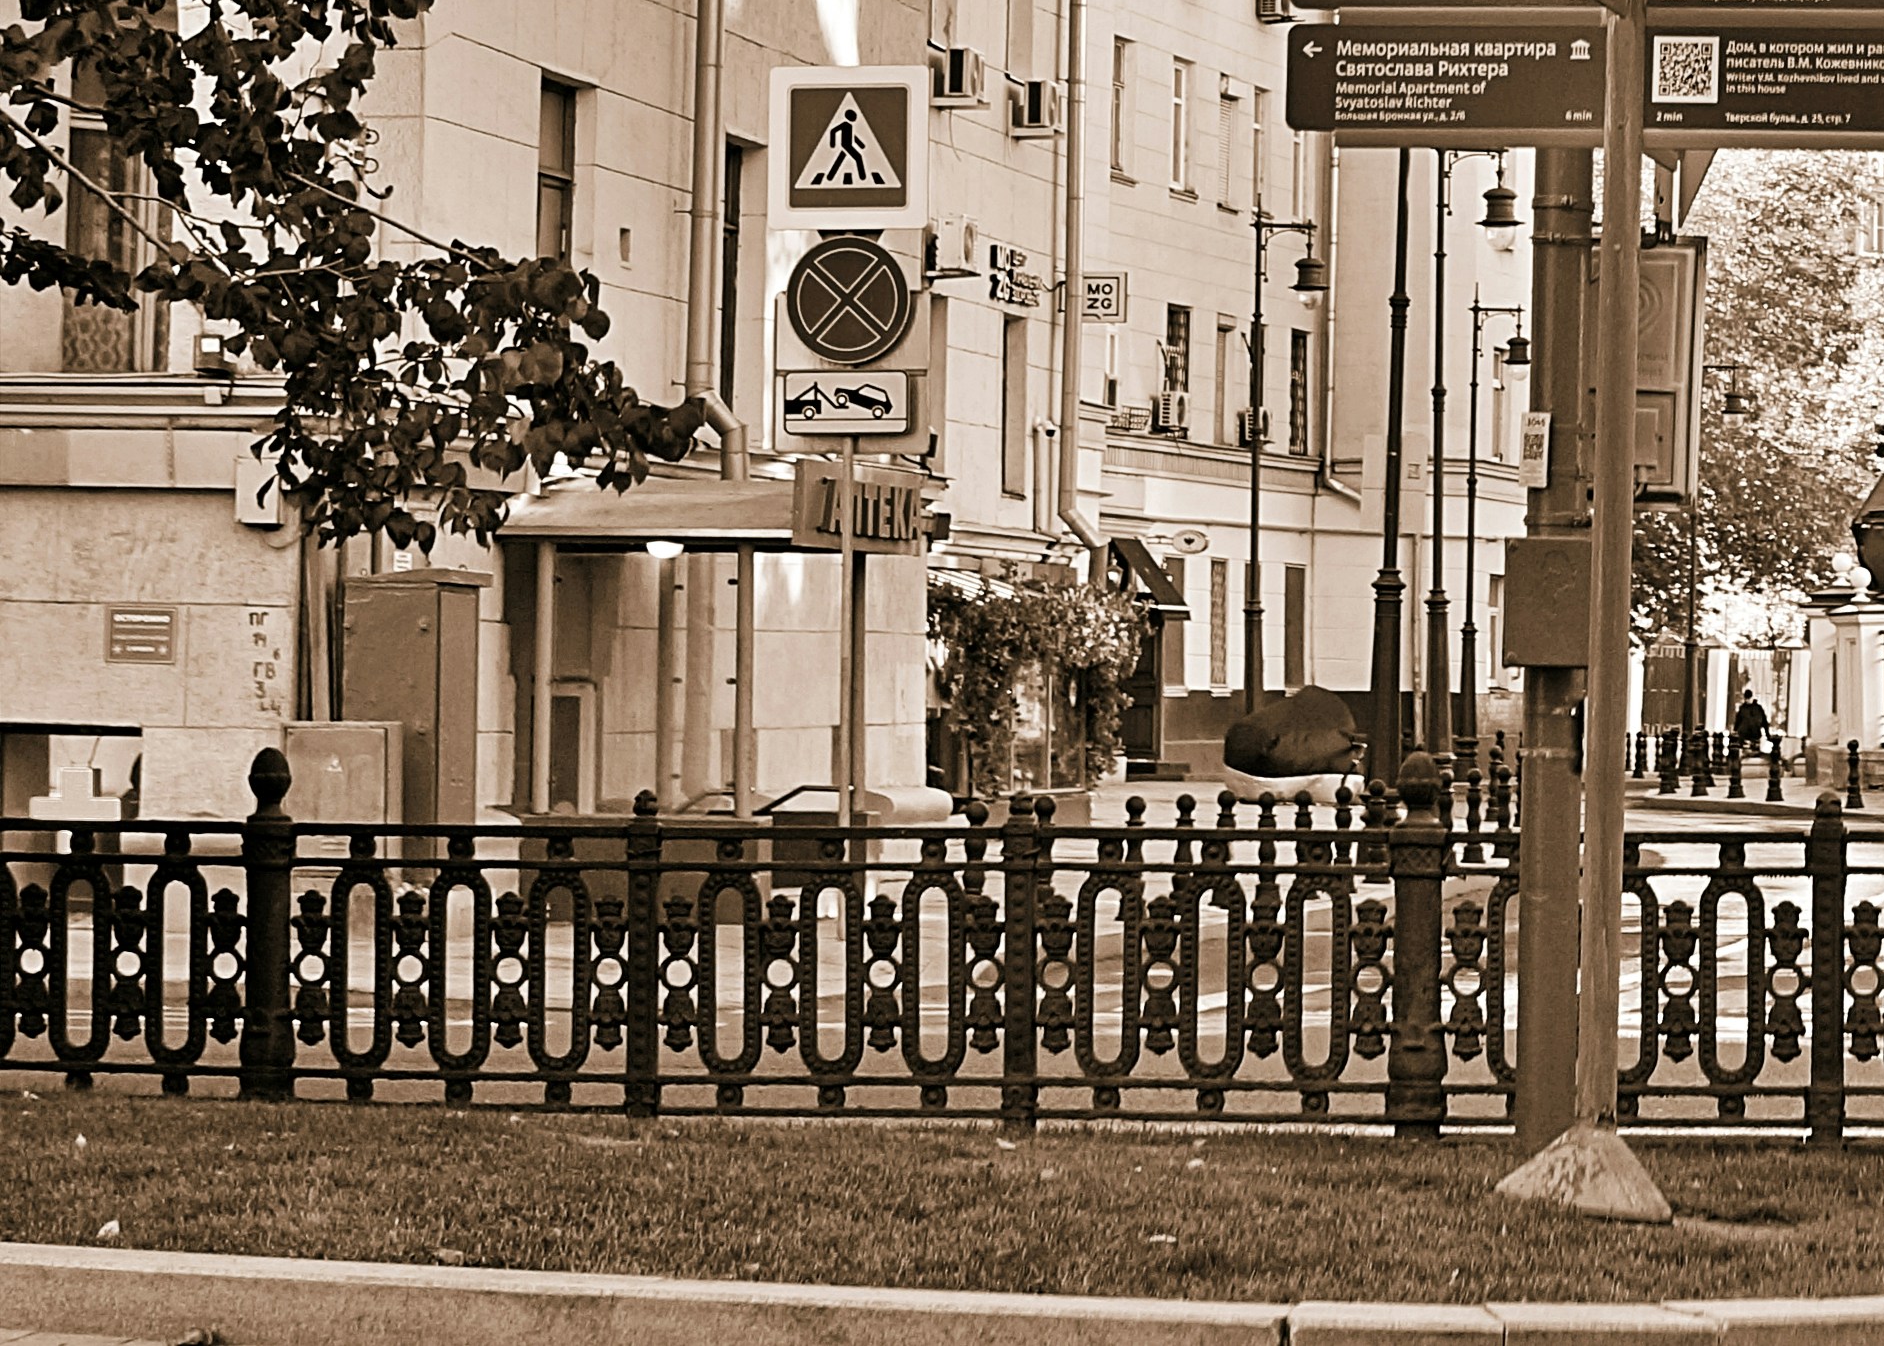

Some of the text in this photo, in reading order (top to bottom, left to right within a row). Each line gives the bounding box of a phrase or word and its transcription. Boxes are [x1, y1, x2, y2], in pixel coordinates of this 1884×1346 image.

[1337, 40, 1556, 60] Мемориальная квартира
[1726, 41, 1756, 56] Дом,
[1759, 44, 1766, 53] в
[1769, 44, 1824, 56] котором
[1827, 44, 1853, 53] жил
[1856, 44, 1864, 54] и
[1336, 60, 1508, 79] Святослава Рихтера
[1726, 58, 1784, 70] писатель
[1787, 58, 1813, 69] В.М.
[1726, 73, 1756, 83] Writer
[1778, 74, 1835, 83] Kozhevnikov
[1837, 74, 1859, 83] lived
[1861, 74, 1879, 84] and
[1335, 82, 1486, 97] Memorial Apartment of
[1726, 85, 1786, 94] in this house
[1335, 96, 1452, 111] Svyatoslav Richter
[1573, 111, 1592, 121] min
[1656, 112, 1683, 122] 2 min
[1725, 112, 1768, 124] Тверской
[1087, 283, 1113, 296] MO
[1086, 297, 1113, 310] ZG
